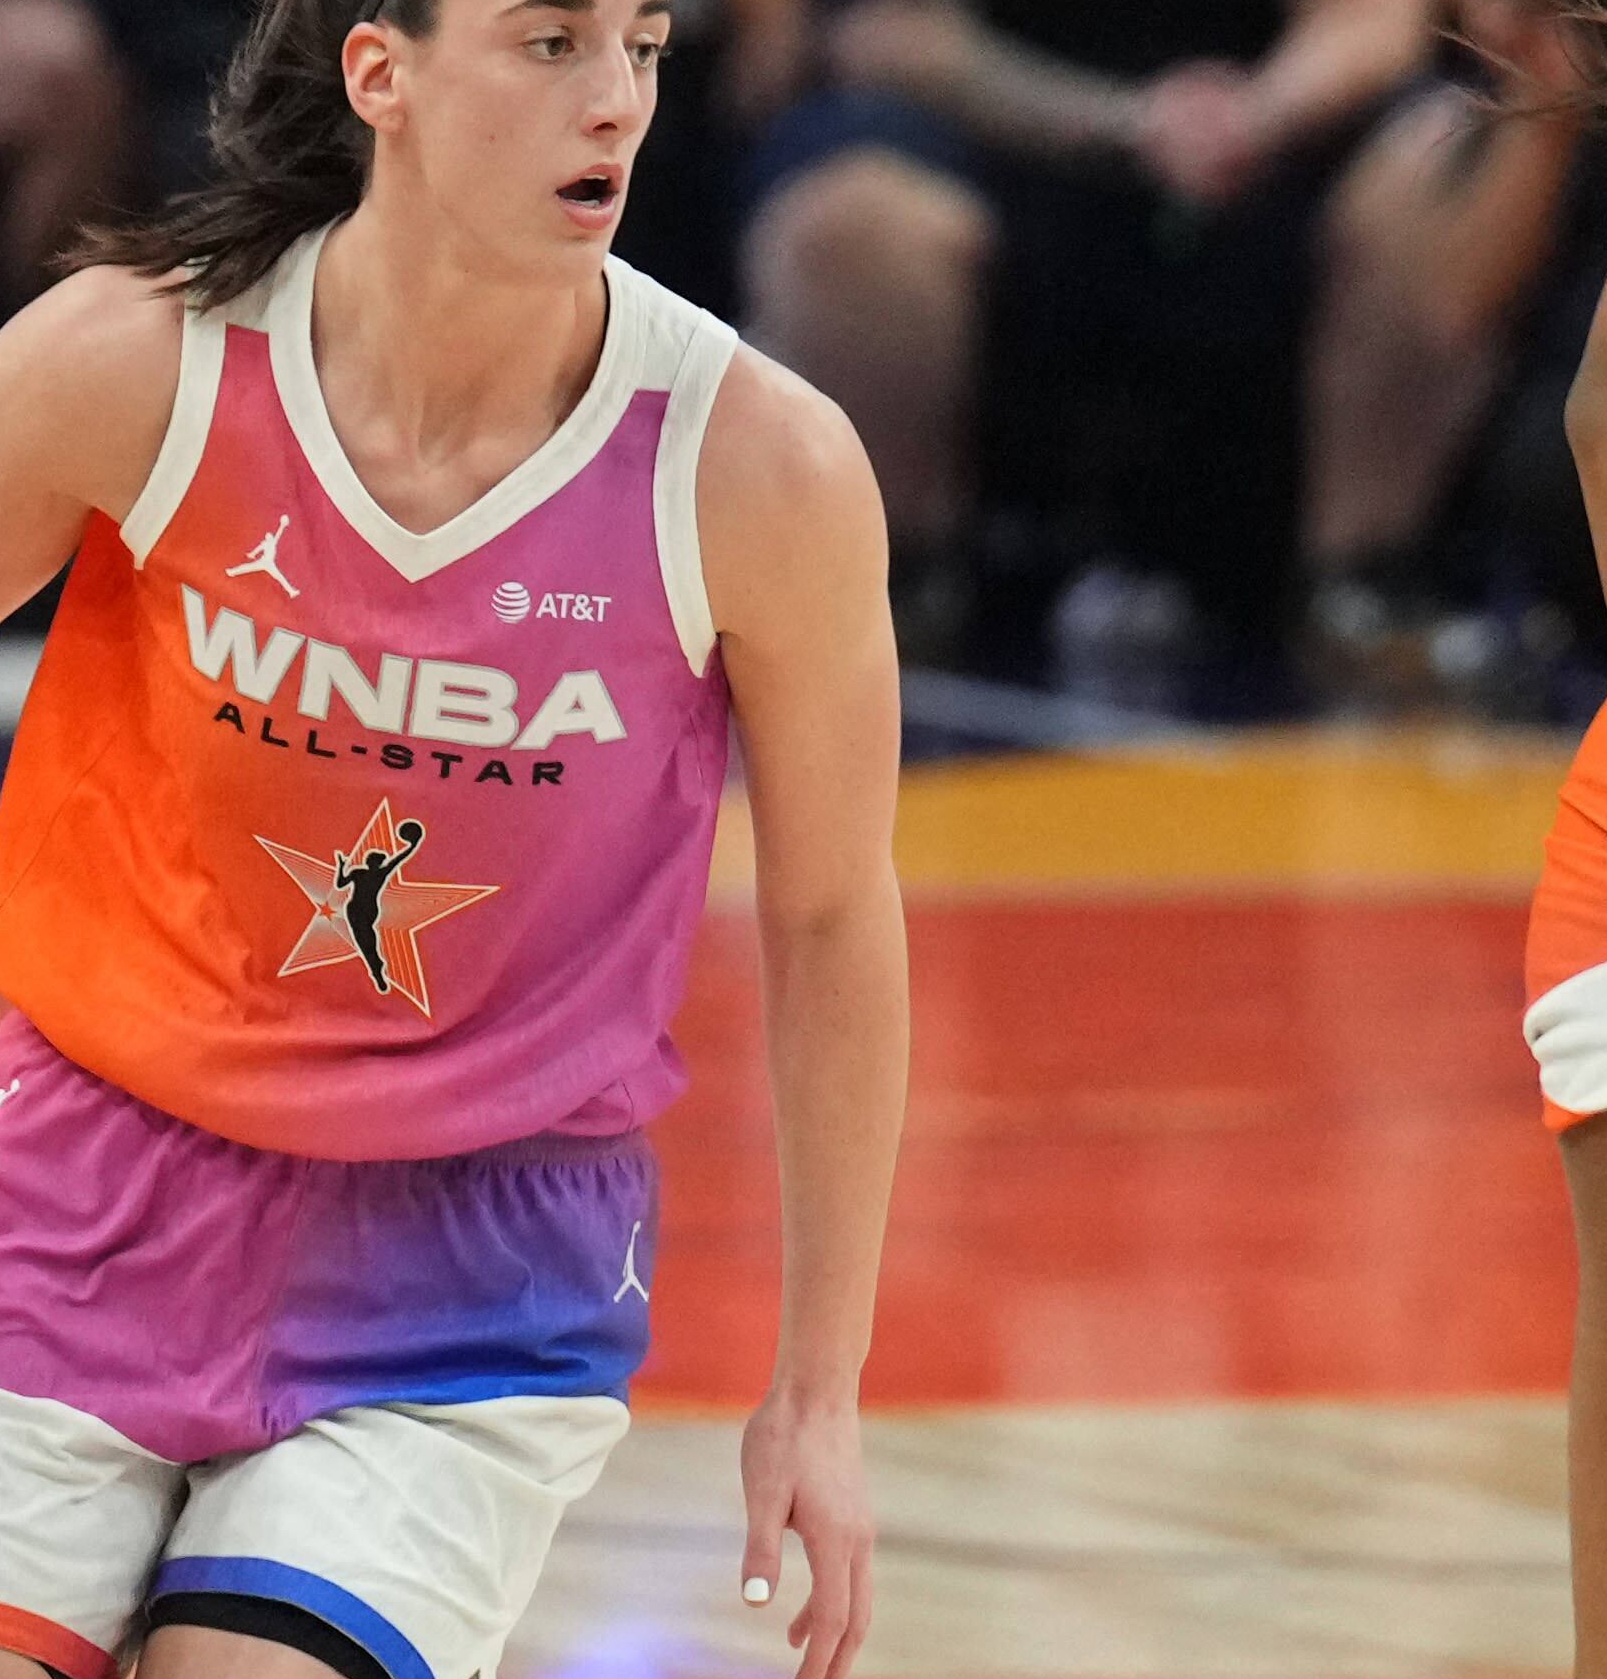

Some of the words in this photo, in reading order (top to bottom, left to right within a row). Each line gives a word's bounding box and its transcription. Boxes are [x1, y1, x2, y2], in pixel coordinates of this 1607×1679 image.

[536, 592, 612, 623] AT&T
[180, 582, 628, 751] WNBA
[214, 700, 566, 786] ALL-STAR
